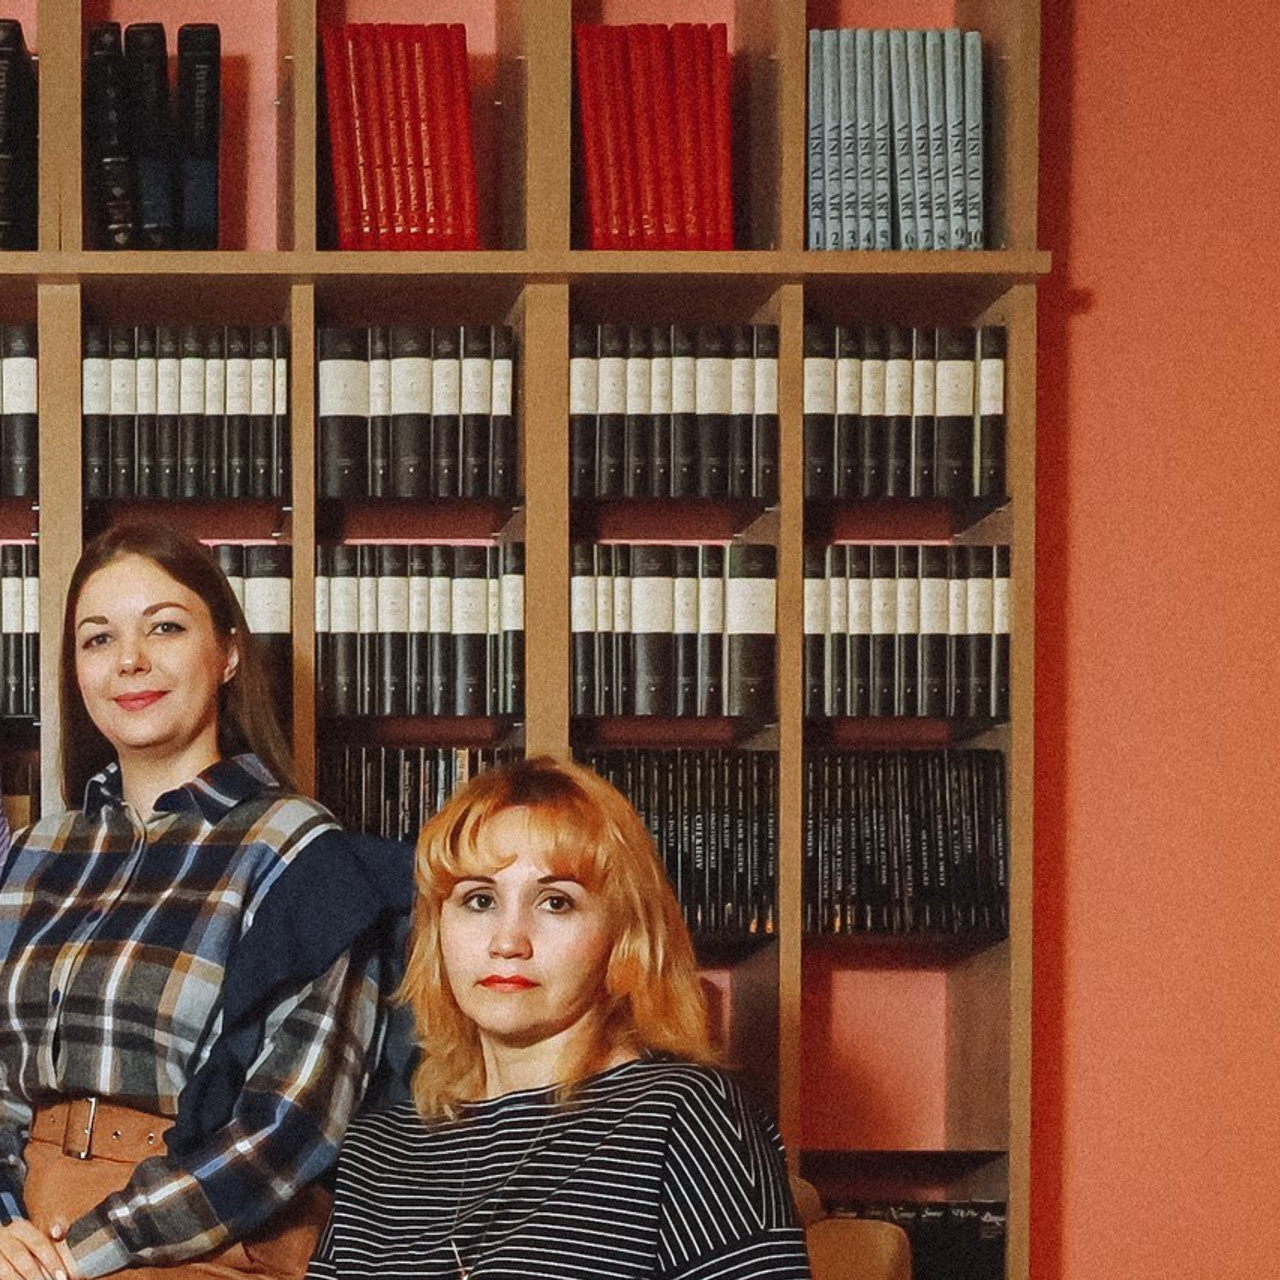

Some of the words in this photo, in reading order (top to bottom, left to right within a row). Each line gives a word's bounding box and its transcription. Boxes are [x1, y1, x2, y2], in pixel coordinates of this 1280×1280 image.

[810, 122, 822, 184] VISUAL
[828, 124, 842, 186] VISUAL
[844, 122, 856, 184] VISUAL
[859, 123, 871, 184] VISUAL
[876, 123, 889, 185] VISUAL
[897, 123, 912, 185] VISUAL
[916, 122, 930, 184] VISUAL
[932, 123, 946, 185] VISUAL
[951, 120, 964, 182] VISUAL
[968, 124, 980, 185] VISUAL
[810, 192, 822, 221] ART
[829, 193, 842, 223] ART
[844, 191, 857, 221] ART
[860, 191, 872, 222] ART
[876, 193, 889, 223] ART
[901, 192, 914, 222] ART
[919, 191, 932, 222] ART
[935, 192, 947, 222] ART
[952, 189, 965, 219] ART
[968, 192, 981, 222] ART
[815, 231, 820, 244] 1
[832, 231, 840, 245] 2
[847, 230, 856, 244] 3
[863, 231, 870, 244] 4
[880, 230, 888, 244] 5
[905, 231, 914, 245] 6
[923, 230, 931, 243] 7
[955, 228, 964, 242] 9
[970, 230, 982, 244] 10
[695, 814, 703, 870] CHEKHOV
